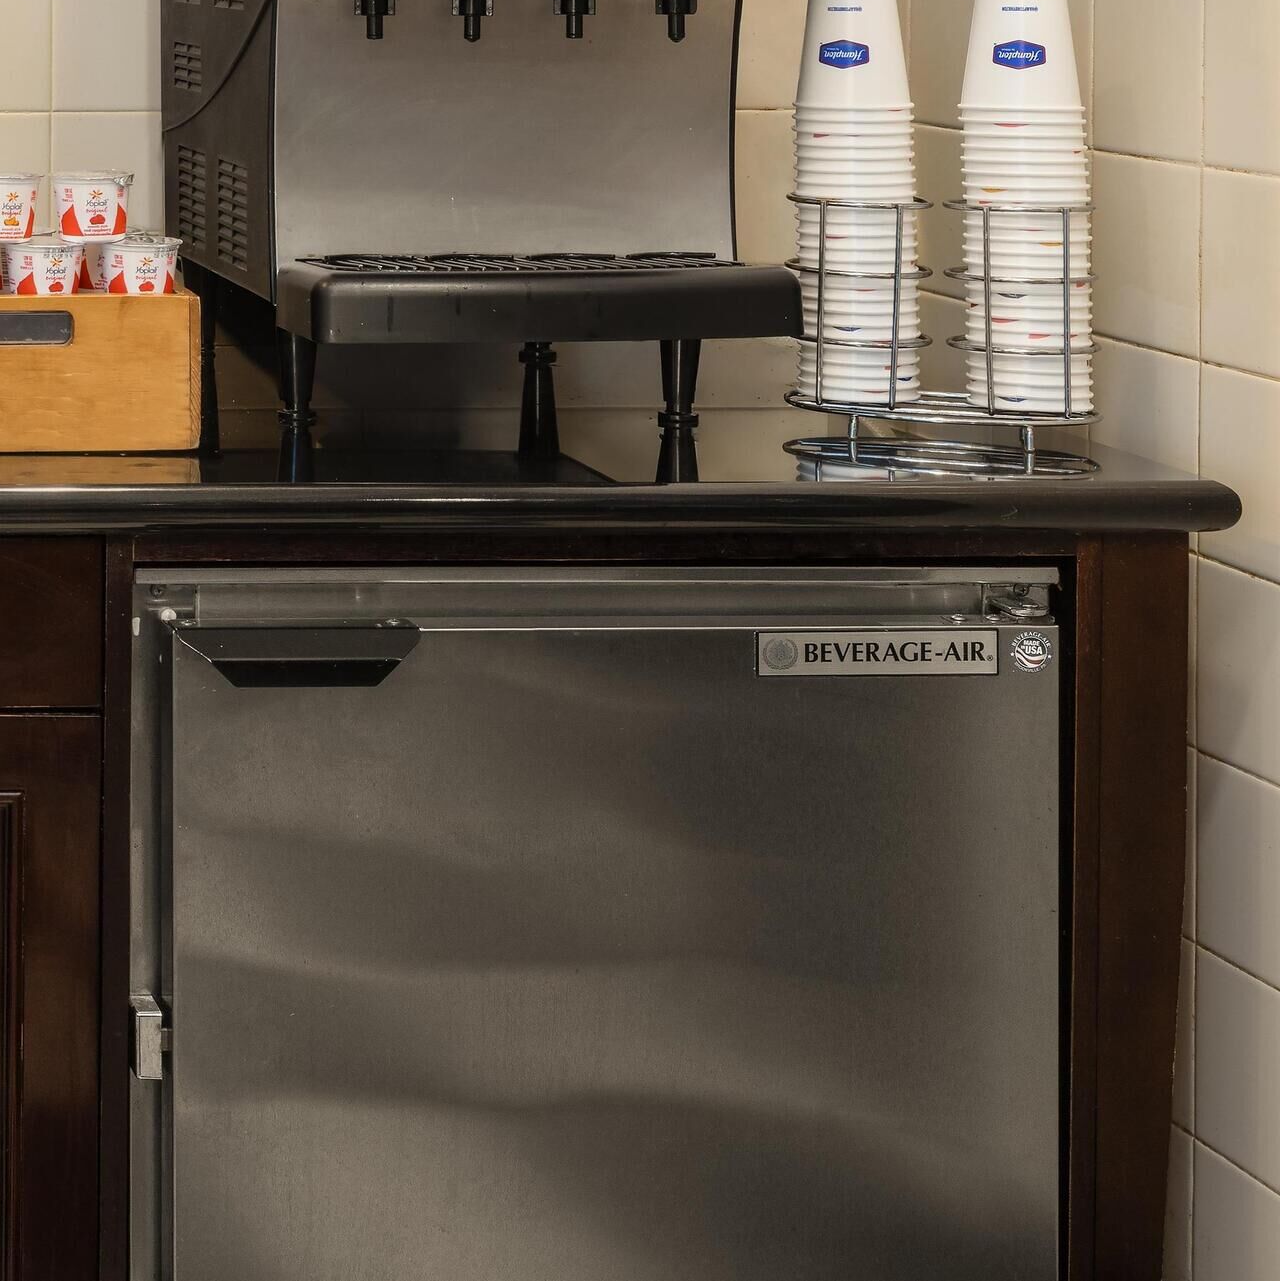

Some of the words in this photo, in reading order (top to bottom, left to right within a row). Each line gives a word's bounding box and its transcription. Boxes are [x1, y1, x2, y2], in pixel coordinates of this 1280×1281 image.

[824, 49, 865, 61] Hampton
[998, 50, 1042, 61] Hampton
[1011, 631, 1051, 647] BEVERAGE-AIR
[804, 642, 986, 663] BEVERAGE-AIR
[1025, 646, 1043, 654] USA
